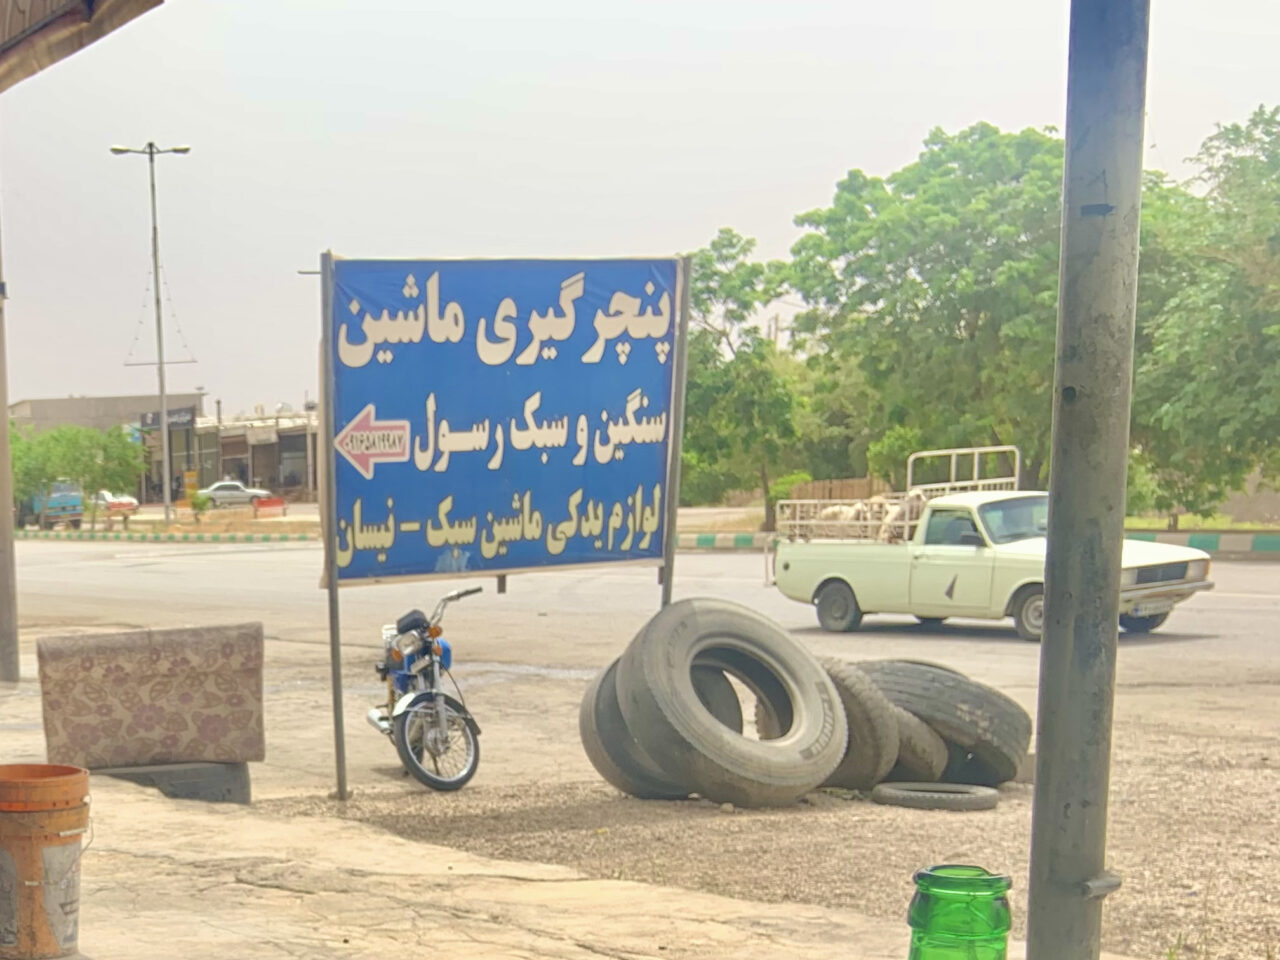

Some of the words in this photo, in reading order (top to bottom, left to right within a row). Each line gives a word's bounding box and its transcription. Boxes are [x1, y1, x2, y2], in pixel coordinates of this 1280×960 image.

[338, 270, 465, 368] ماشین
[476, 271, 585, 366] گیری
[581, 280, 670, 365] پنچر
[414, 392, 504, 472] رسول
[510, 391, 568, 464] سبک
[572, 414, 588, 466] و
[594, 387, 666, 464] سنگین
[336, 498, 395, 567] نیسان
[427, 495, 477, 558] سبک
[481, 489, 542, 559] ماشین
[546, 488, 603, 555] یدکی
[608, 482, 661, 551] لوازم
